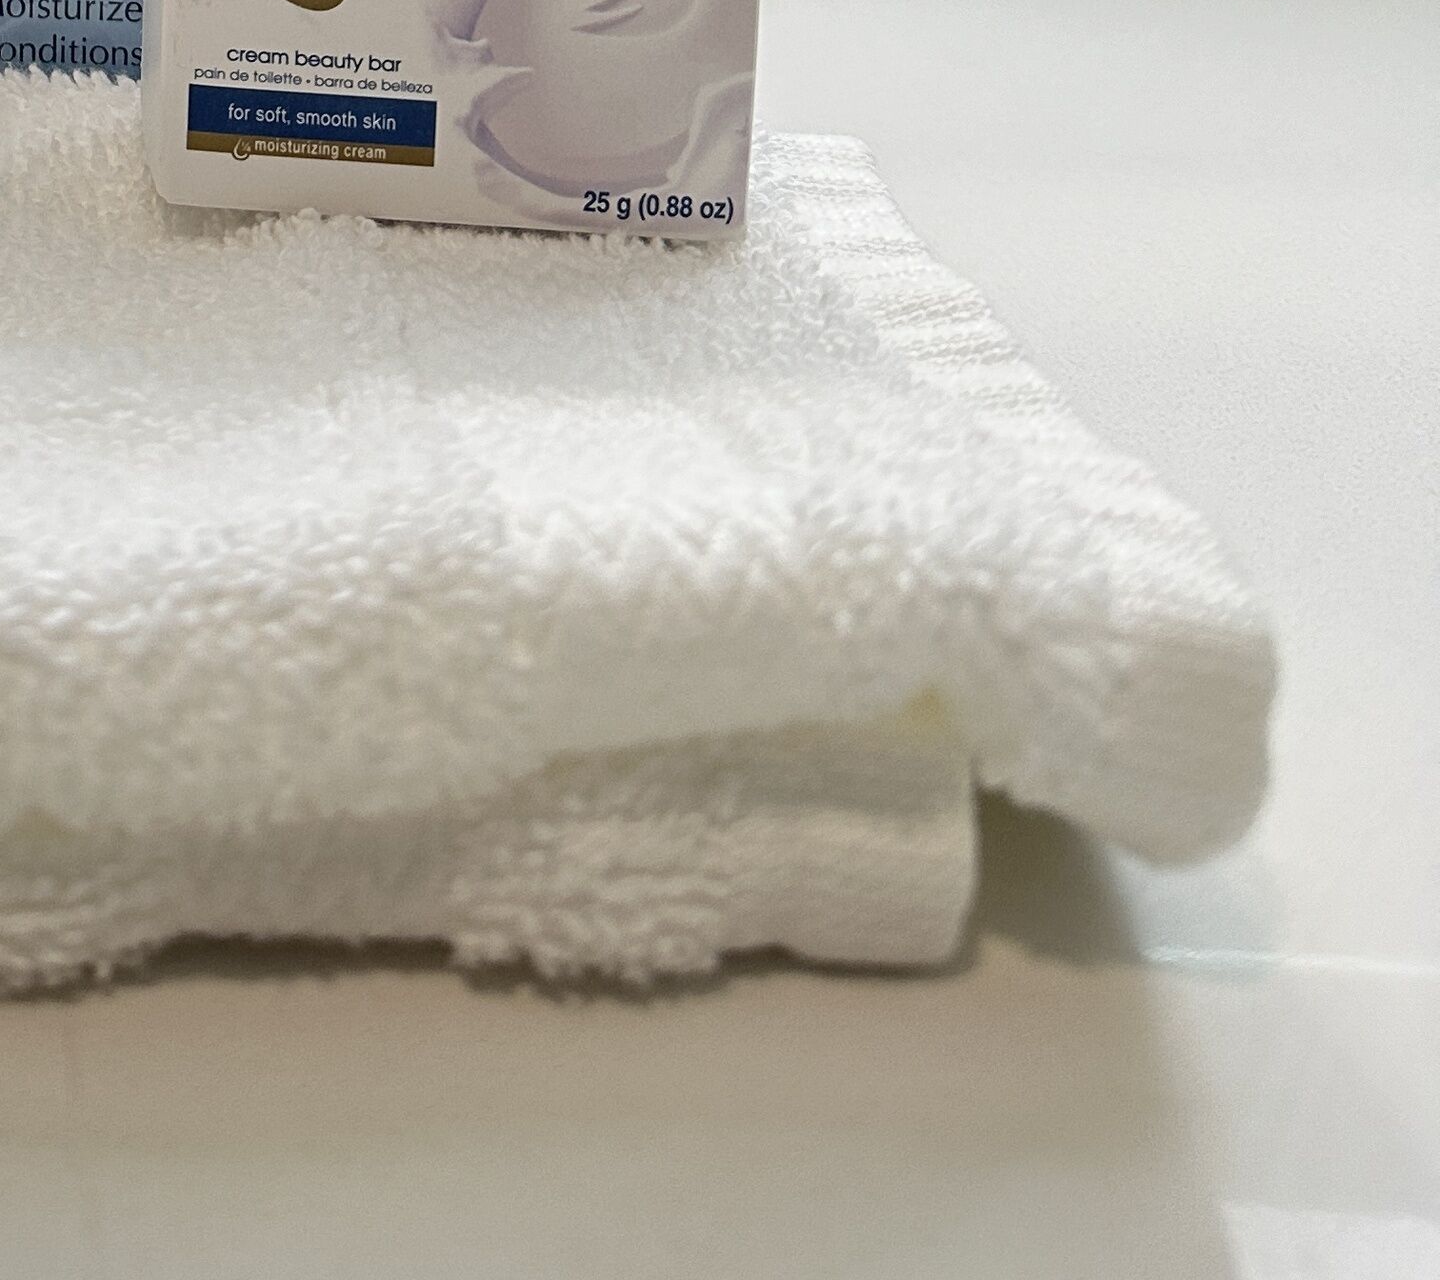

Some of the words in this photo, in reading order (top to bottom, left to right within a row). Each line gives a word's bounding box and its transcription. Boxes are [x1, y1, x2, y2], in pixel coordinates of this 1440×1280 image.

[226, 48, 289, 65] cream
[295, 50, 364, 73] beauty
[368, 55, 402, 72] bar
[193, 67, 225, 80] pain
[230, 70, 249, 82] de
[253, 71, 302, 86] toilette
[314, 74, 353, 89] barra
[357, 78, 377, 91] de
[381, 80, 433, 95] belleza
[228, 103, 250, 121] for
[255, 106, 291, 126] soft,
[296, 110, 357, 129] smooth
[362, 113, 397, 131] skin
[254, 139, 339, 160] moisturizing
[343, 147, 387, 160] cream
[583, 190, 610, 213] 25
[617, 197, 630, 219] g
[638, 192, 693, 221] (0.88
[699, 196, 734, 225] oz)
